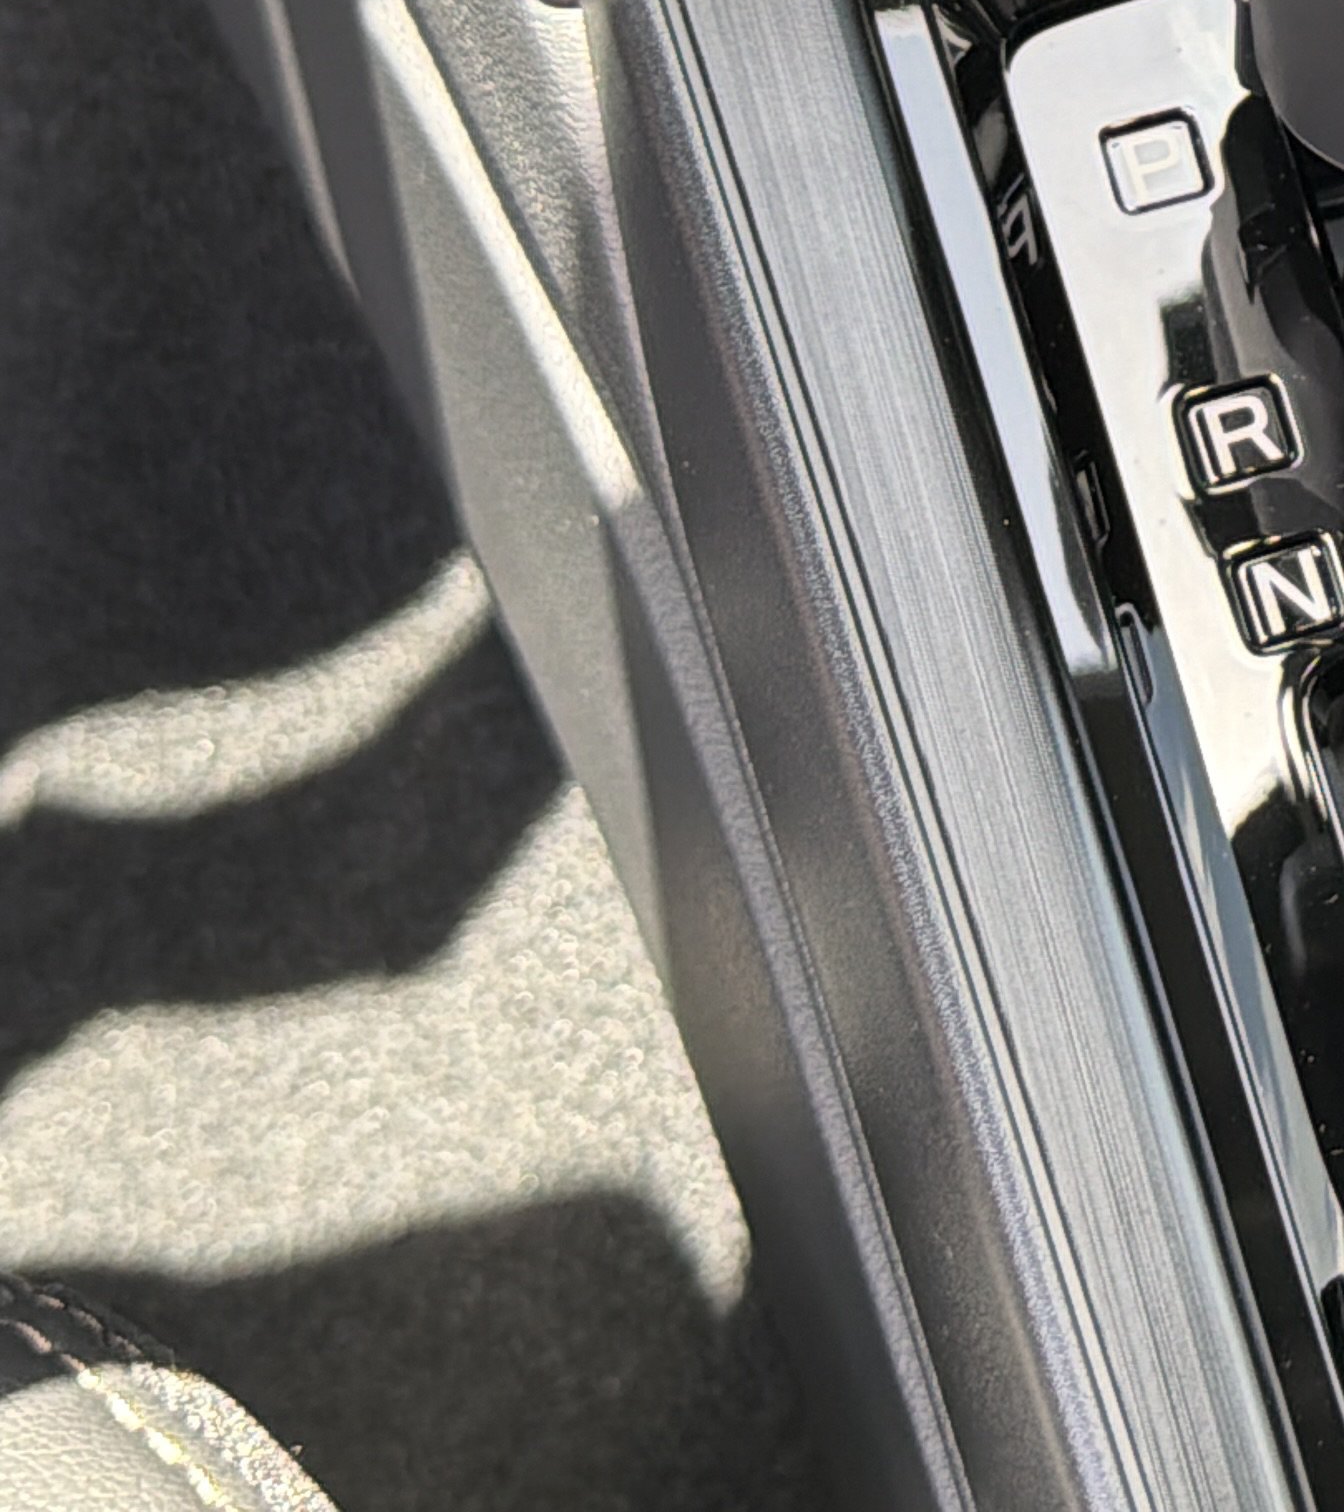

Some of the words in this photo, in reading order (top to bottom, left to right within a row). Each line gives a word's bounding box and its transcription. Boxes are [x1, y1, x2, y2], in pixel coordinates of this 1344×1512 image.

[1124, 134, 1181, 203] P
[1205, 395, 1285, 475] R
[1252, 545, 1332, 635] N
